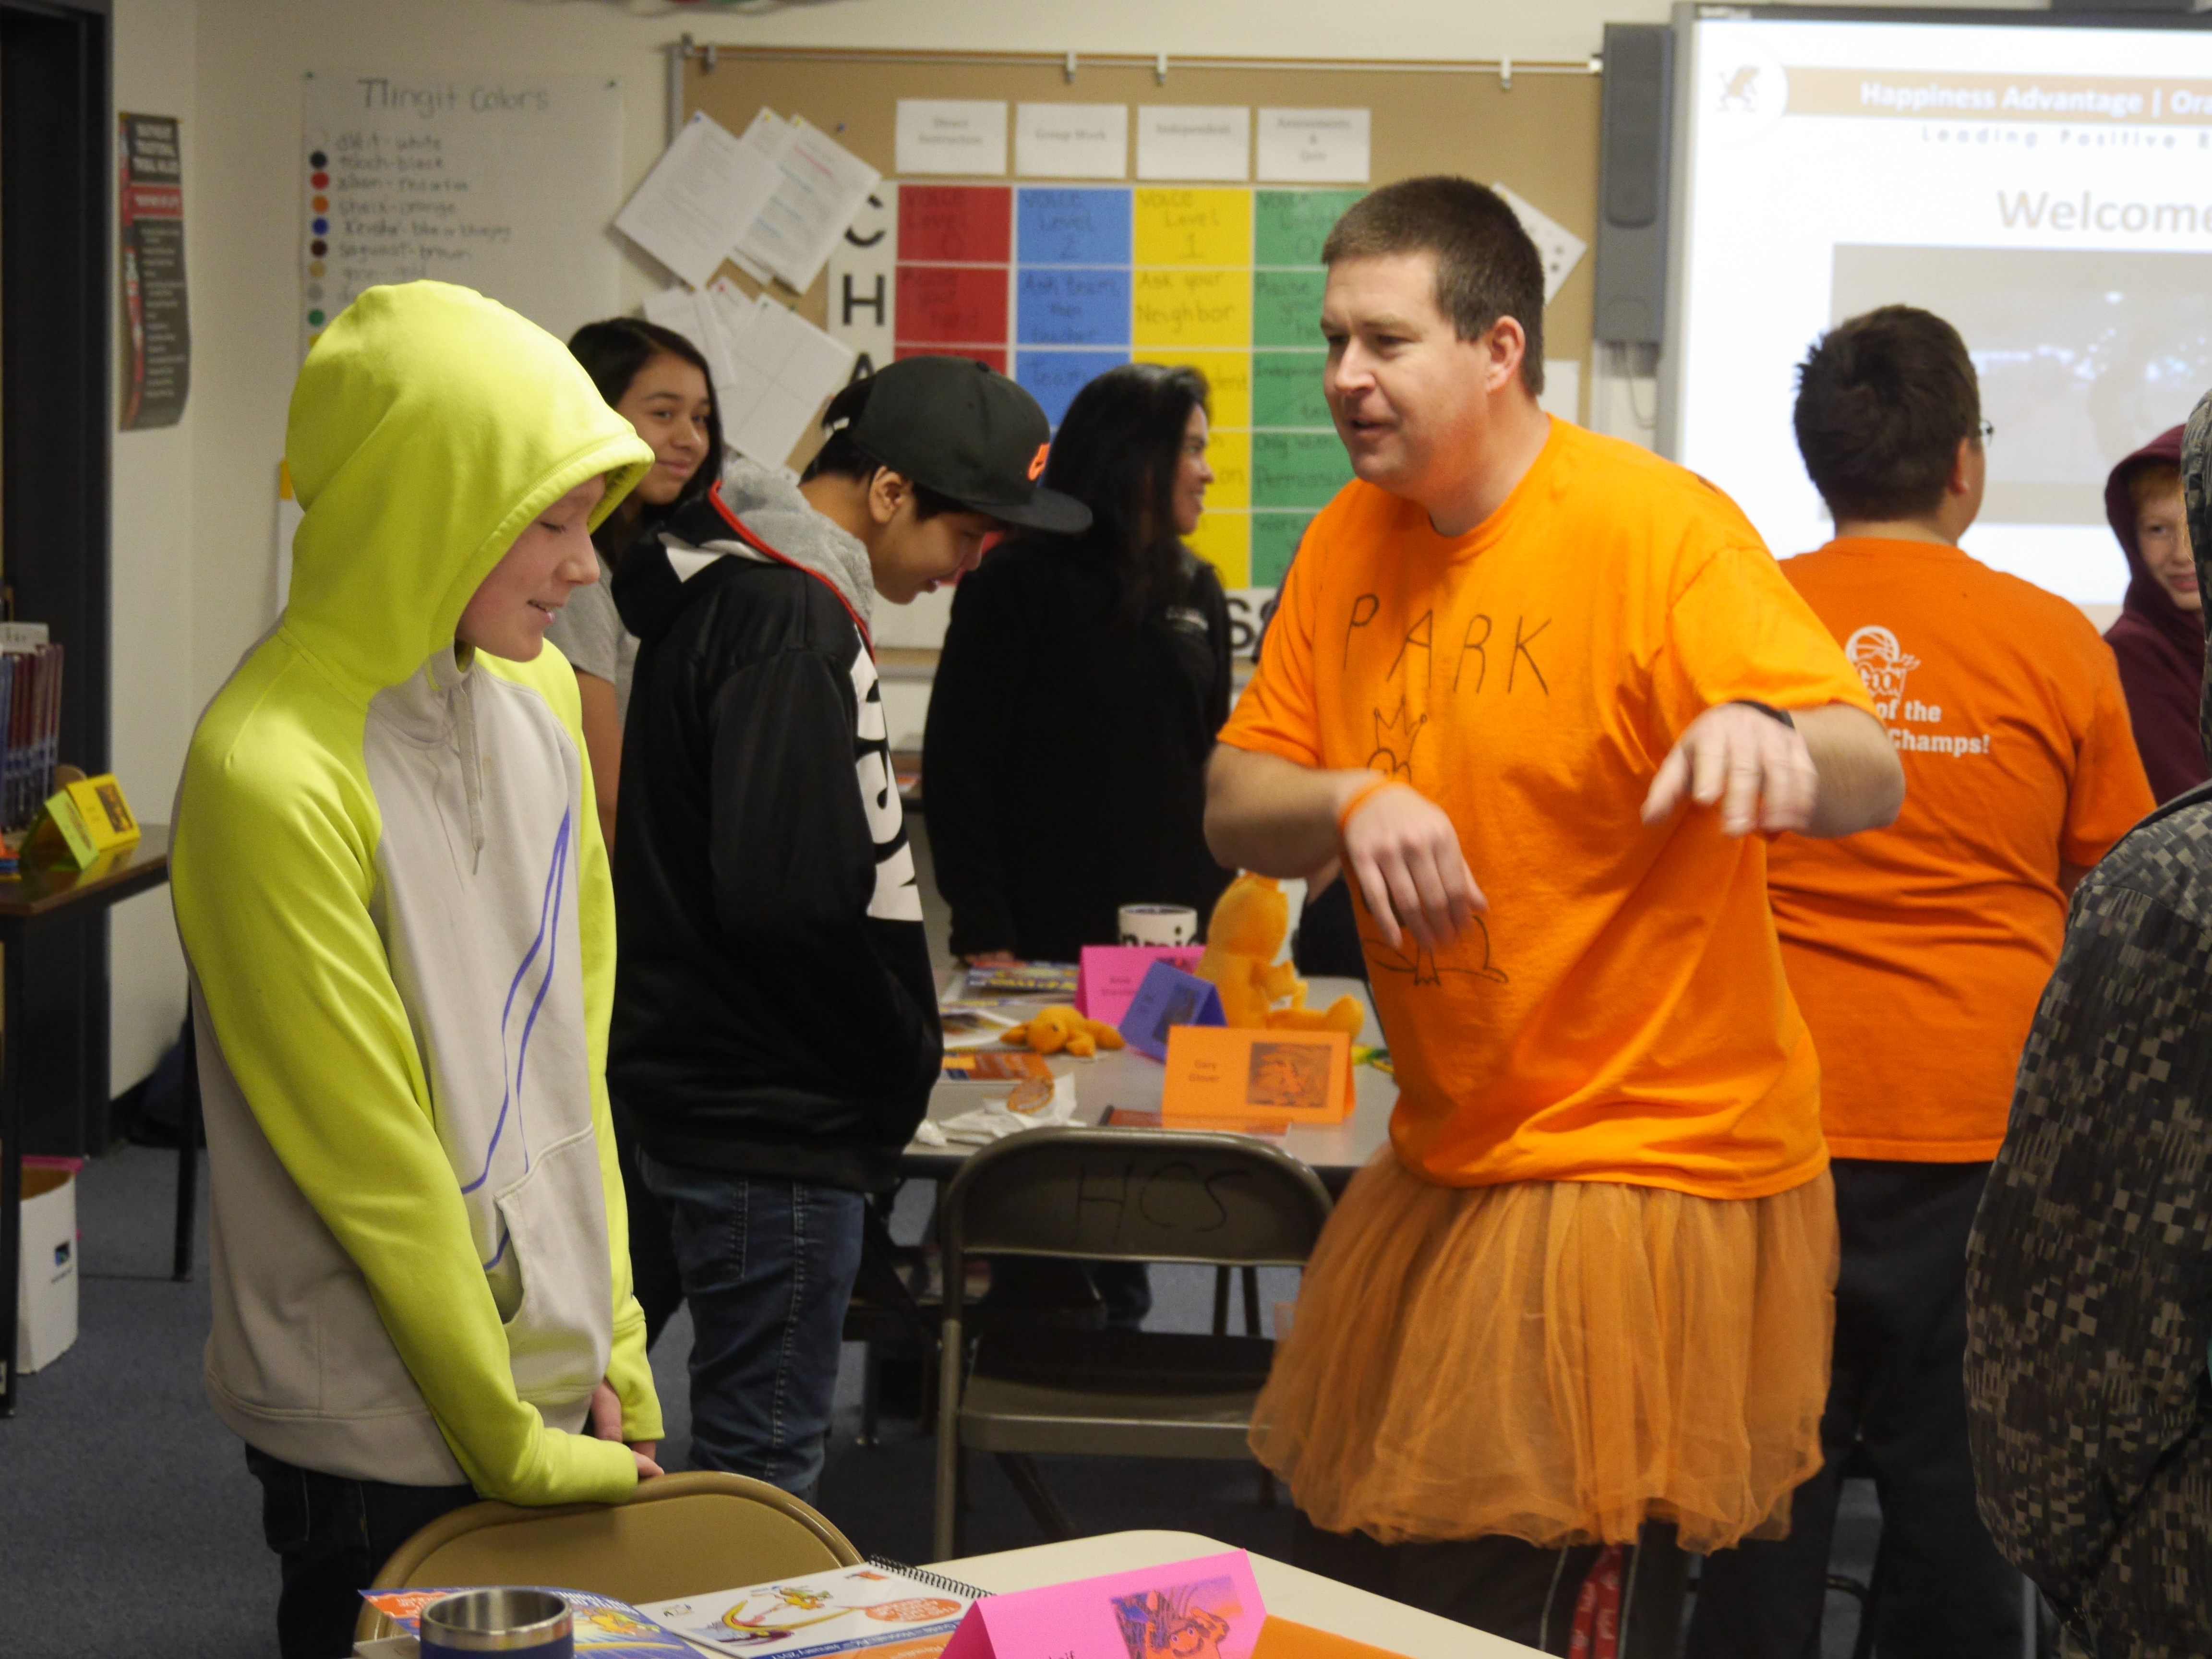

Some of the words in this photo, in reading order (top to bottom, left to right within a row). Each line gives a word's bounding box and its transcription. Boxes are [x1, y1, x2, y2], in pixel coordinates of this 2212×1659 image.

[1861, 83, 1996, 111] Happiness
[2002, 85, 2144, 118] Advantage
[1922, 126, 2040, 149] Leading
[2060, 128, 2176, 148] Positive
[1344, 593, 1552, 695] PARK
[1876, 699, 1900, 720] of
[1904, 699, 1942, 723] the
[1887, 728, 1991, 758] Champs!
[1071, 1161, 1254, 1245] HCS
